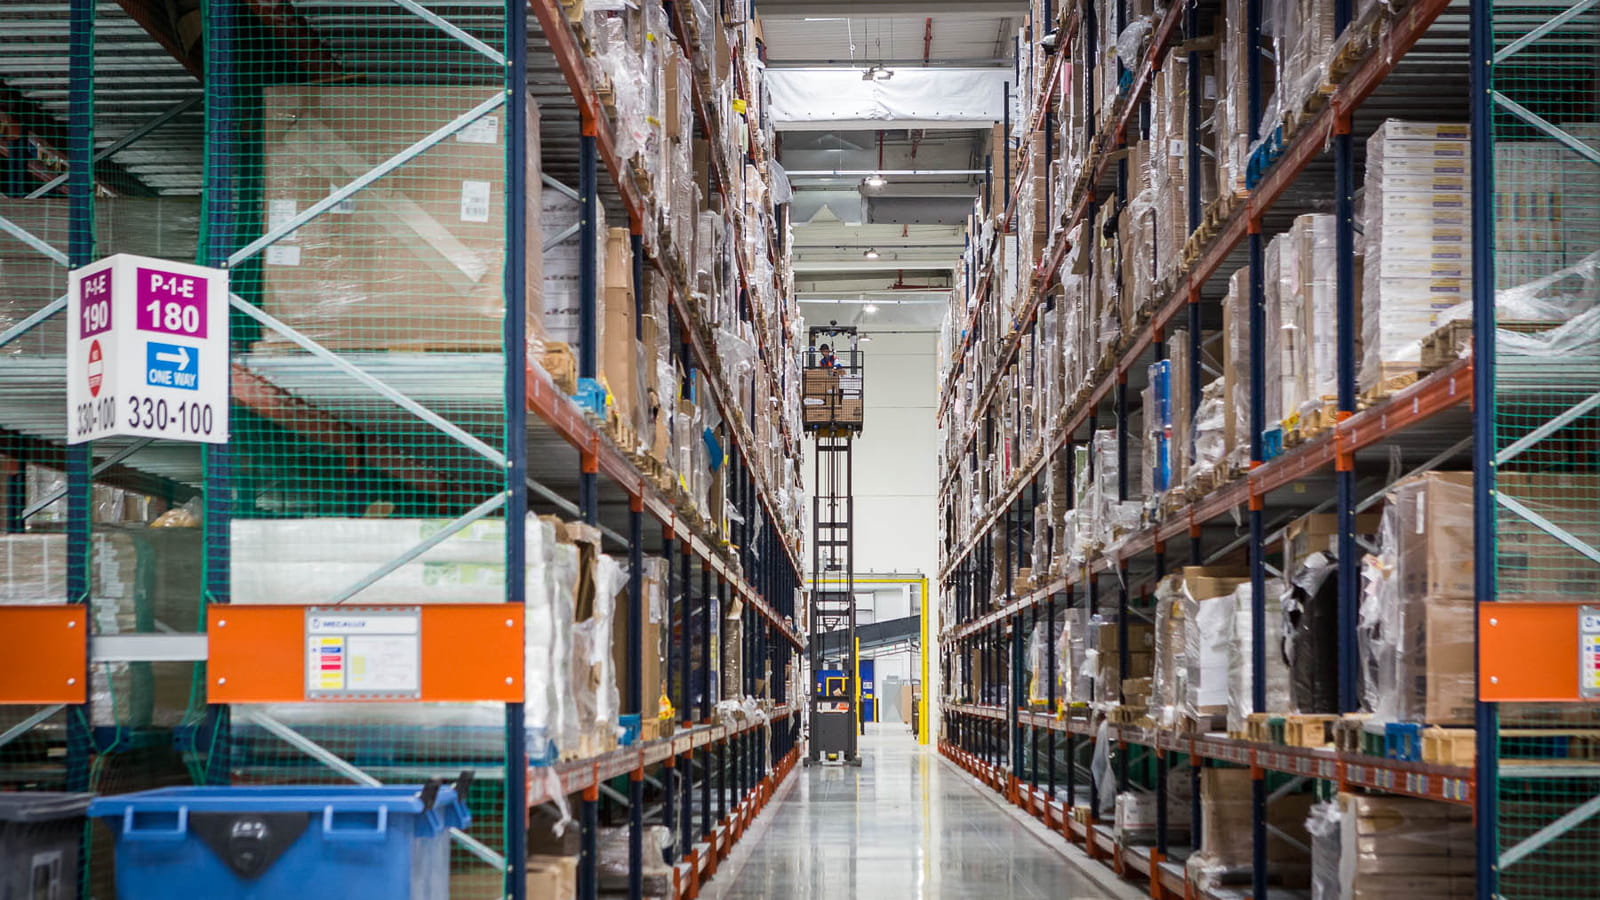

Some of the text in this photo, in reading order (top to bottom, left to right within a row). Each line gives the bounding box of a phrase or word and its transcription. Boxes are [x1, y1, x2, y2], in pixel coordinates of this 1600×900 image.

[85, 274, 106, 298] P-1-E
[151, 274, 194, 298] P-1-E
[83, 300, 109, 333] 190
[146, 300, 199, 333] 180
[149, 369, 197, 388] ONE WAY
[77, 396, 116, 436] 330-100
[128, 396, 212, 435] 330-100
